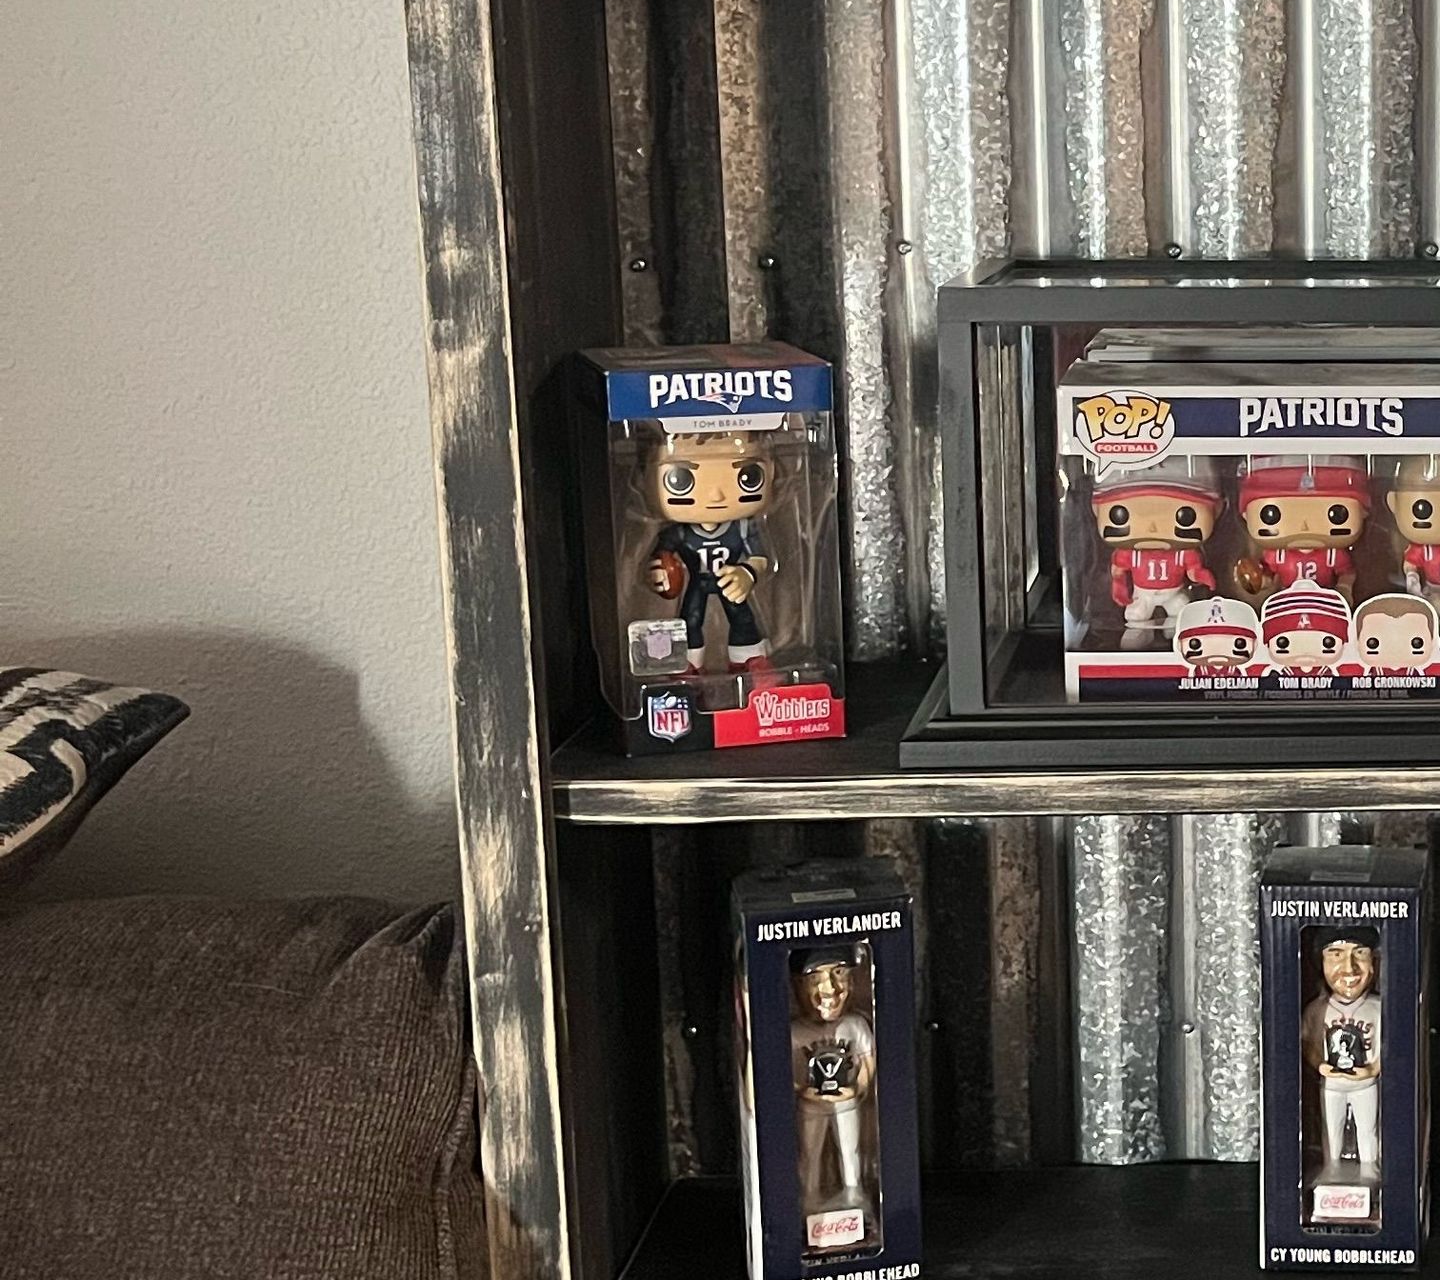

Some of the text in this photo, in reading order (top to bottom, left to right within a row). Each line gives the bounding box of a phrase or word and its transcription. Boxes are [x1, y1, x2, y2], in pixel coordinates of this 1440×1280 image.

[649, 370, 793, 409] PATRIOTS
[693, 420, 753, 429] TOM BRADY
[1077, 394, 1173, 443] POP!
[1239, 398, 1404, 437] PATRIOTS
[1096, 444, 1157, 453] FOOTBALL
[1147, 559, 1169, 581] 11
[1296, 561, 1317, 580] 12
[1178, 677, 1259, 689] JULIAN EDELMAN
[1278, 677, 1333, 689] TOM BRADY
[1352, 677, 1436, 689] ROB GRONKOWSKI
[753, 691, 830, 726] Wobblers
[655, 709, 690, 732] NFL
[1271, 900, 1409, 919] JUSTIN VERLANDER
[757, 911, 902, 942] JUSTIN VERLANDER
[1270, 1248, 1416, 1264] CY YOUNG BOBBLEHEAD
